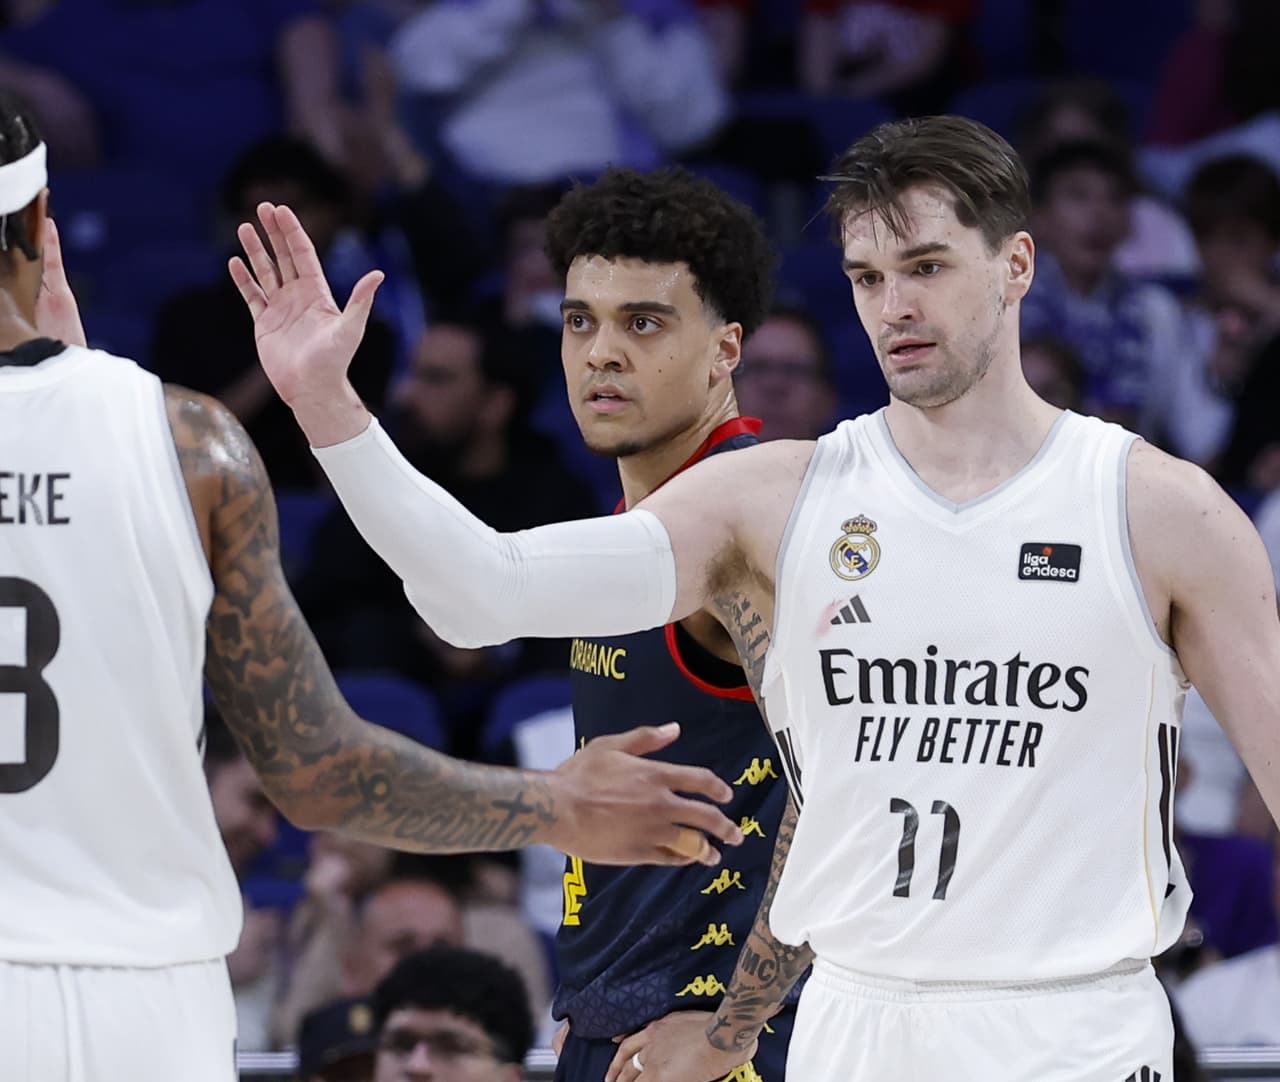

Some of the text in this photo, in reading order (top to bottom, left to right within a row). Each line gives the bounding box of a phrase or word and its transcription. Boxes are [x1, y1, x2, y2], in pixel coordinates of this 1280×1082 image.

[1022, 565, 1076, 579] endesa
[1023, 552, 1049, 566] liga
[819, 645, 1090, 712] Emirates
[854, 716, 1043, 768] FLY BETTER
[889, 797, 961, 901] 11
